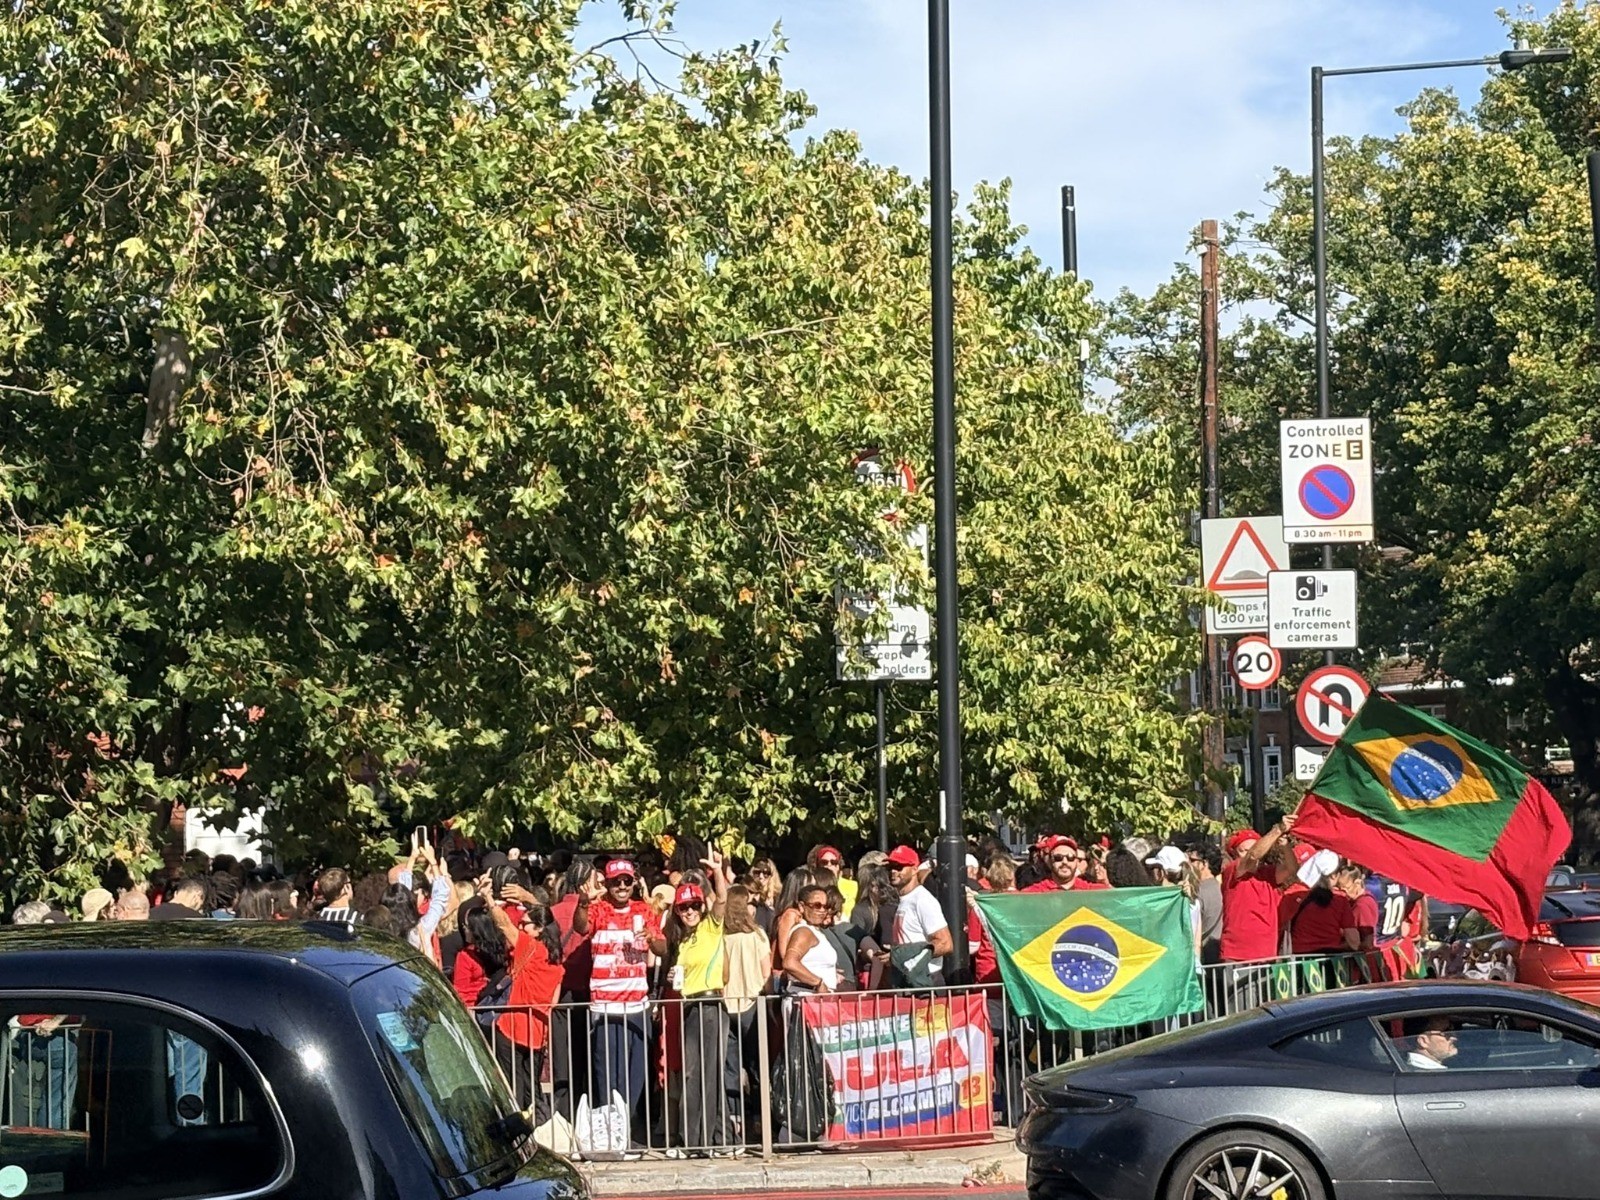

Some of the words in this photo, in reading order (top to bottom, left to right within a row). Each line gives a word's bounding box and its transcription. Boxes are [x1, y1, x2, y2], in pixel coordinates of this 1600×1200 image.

[1287, 424, 1364, 437] Controlled
[1288, 444, 1342, 458] ZONE
[1348, 441, 1362, 459] E
[1292, 606, 1332, 617] Traffic
[1220, 613, 1245, 624] 300
[1248, 614, 1268, 624] yar
[1274, 619, 1351, 630] enforcement
[1287, 632, 1338, 642] cameras
[883, 664, 927, 674] holders
[1237, 652, 1272, 673] 20
[1381, 895, 1404, 935] 10
[834, 1036, 969, 1093] ULA
[961, 1075, 981, 1101] 13
